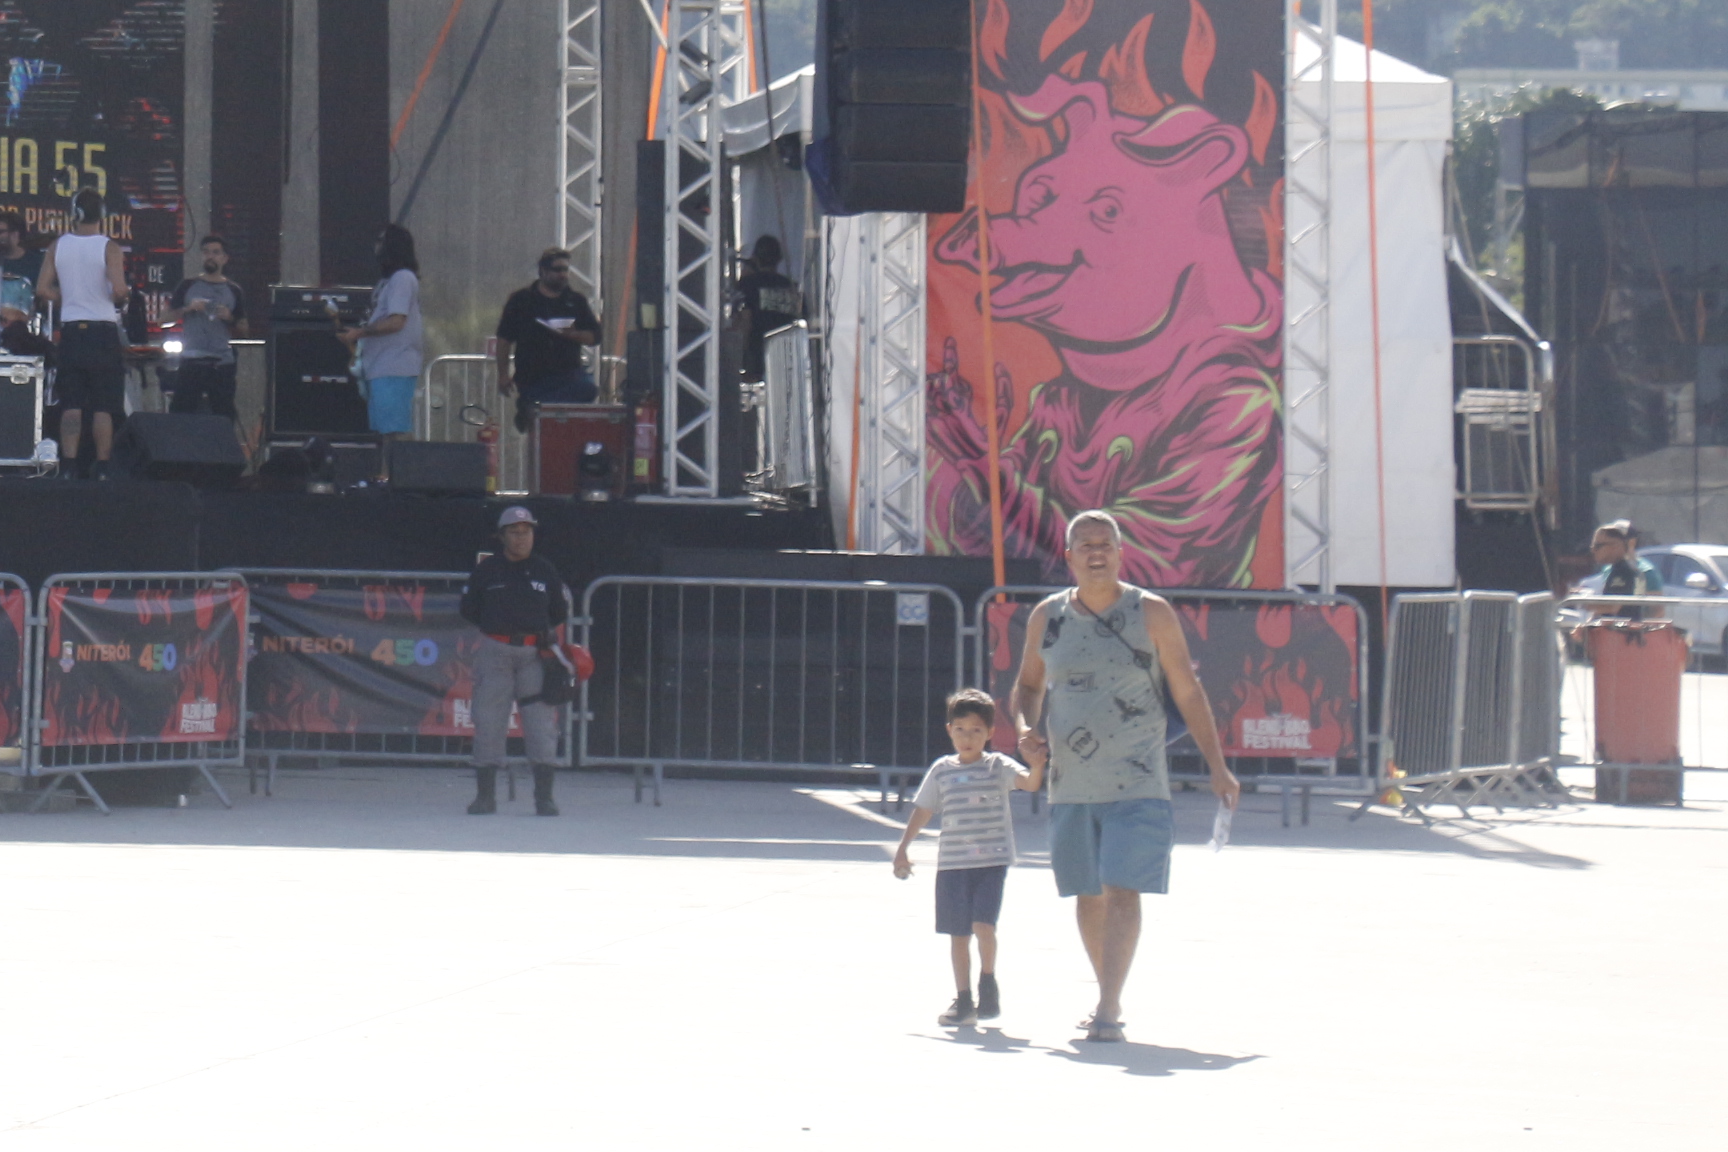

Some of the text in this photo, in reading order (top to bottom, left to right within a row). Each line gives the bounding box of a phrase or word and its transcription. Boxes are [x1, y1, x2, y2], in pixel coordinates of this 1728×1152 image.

[54, 142, 107, 198] 55
[139, 643, 176, 671] 450
[370, 638, 438, 666] 450
